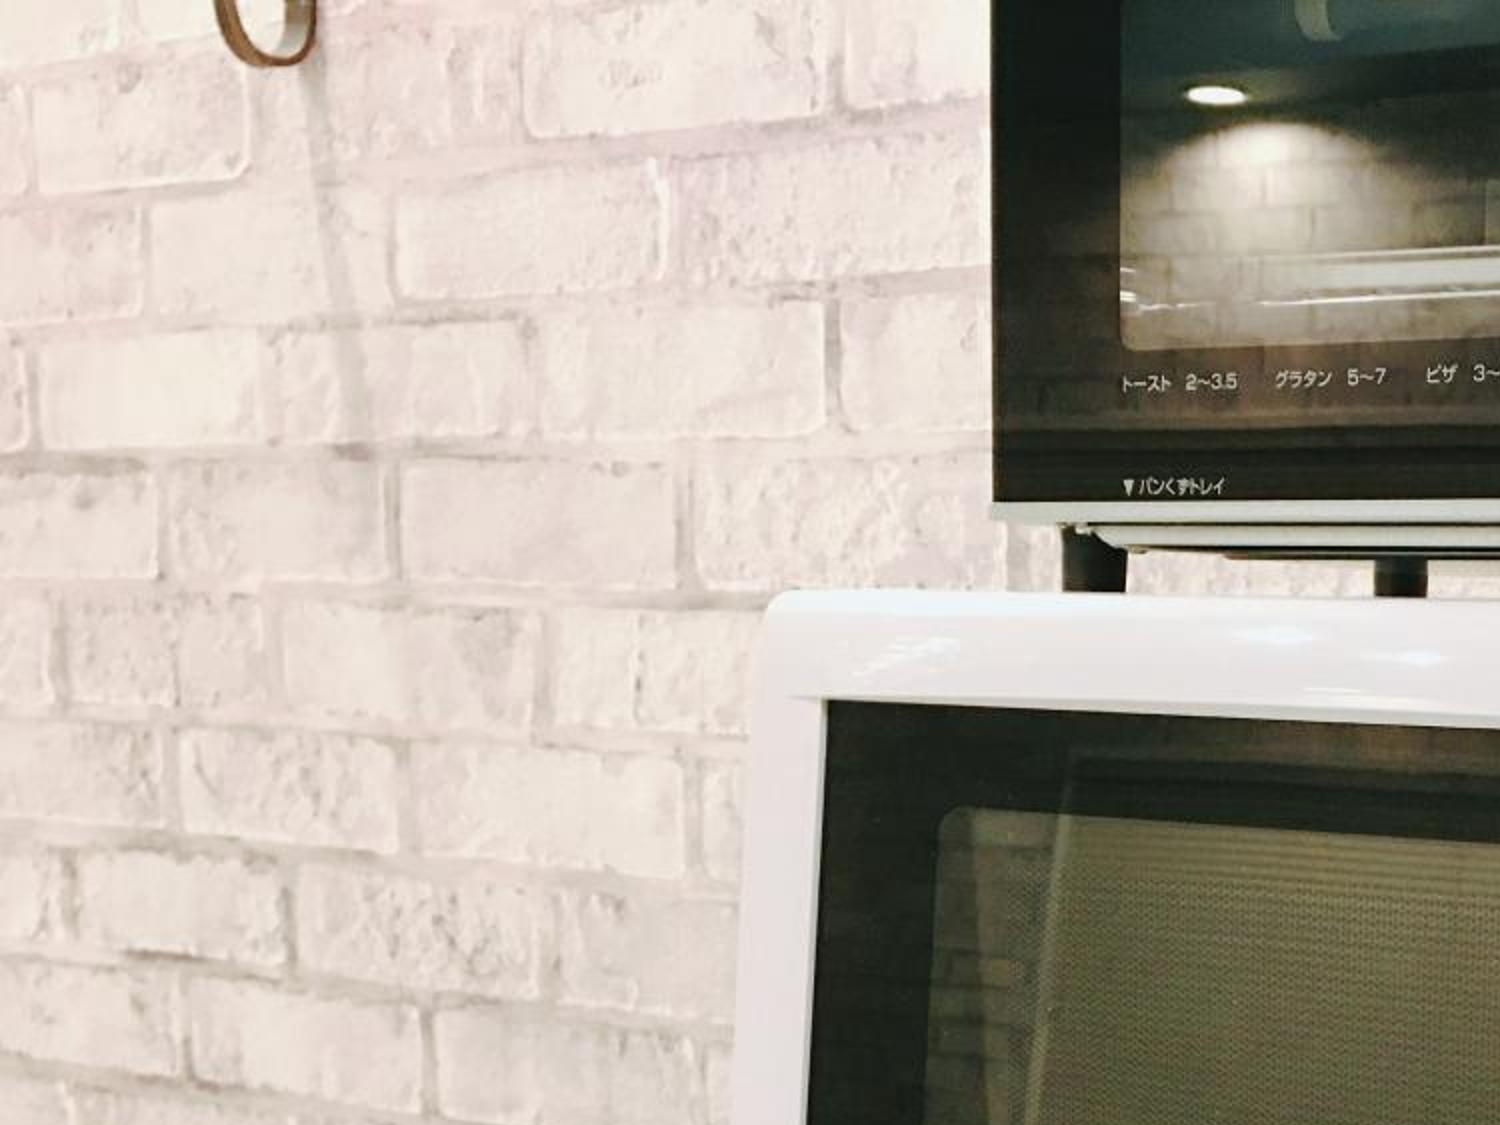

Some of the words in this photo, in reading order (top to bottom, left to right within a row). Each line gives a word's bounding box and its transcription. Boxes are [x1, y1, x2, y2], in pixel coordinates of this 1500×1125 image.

[1122, 374, 1172, 392] トースト
[1275, 370, 1332, 388] グラタン
[1426, 364, 1457, 384] ピザ
[1140, 478, 1225, 495] パンくずトレイ
